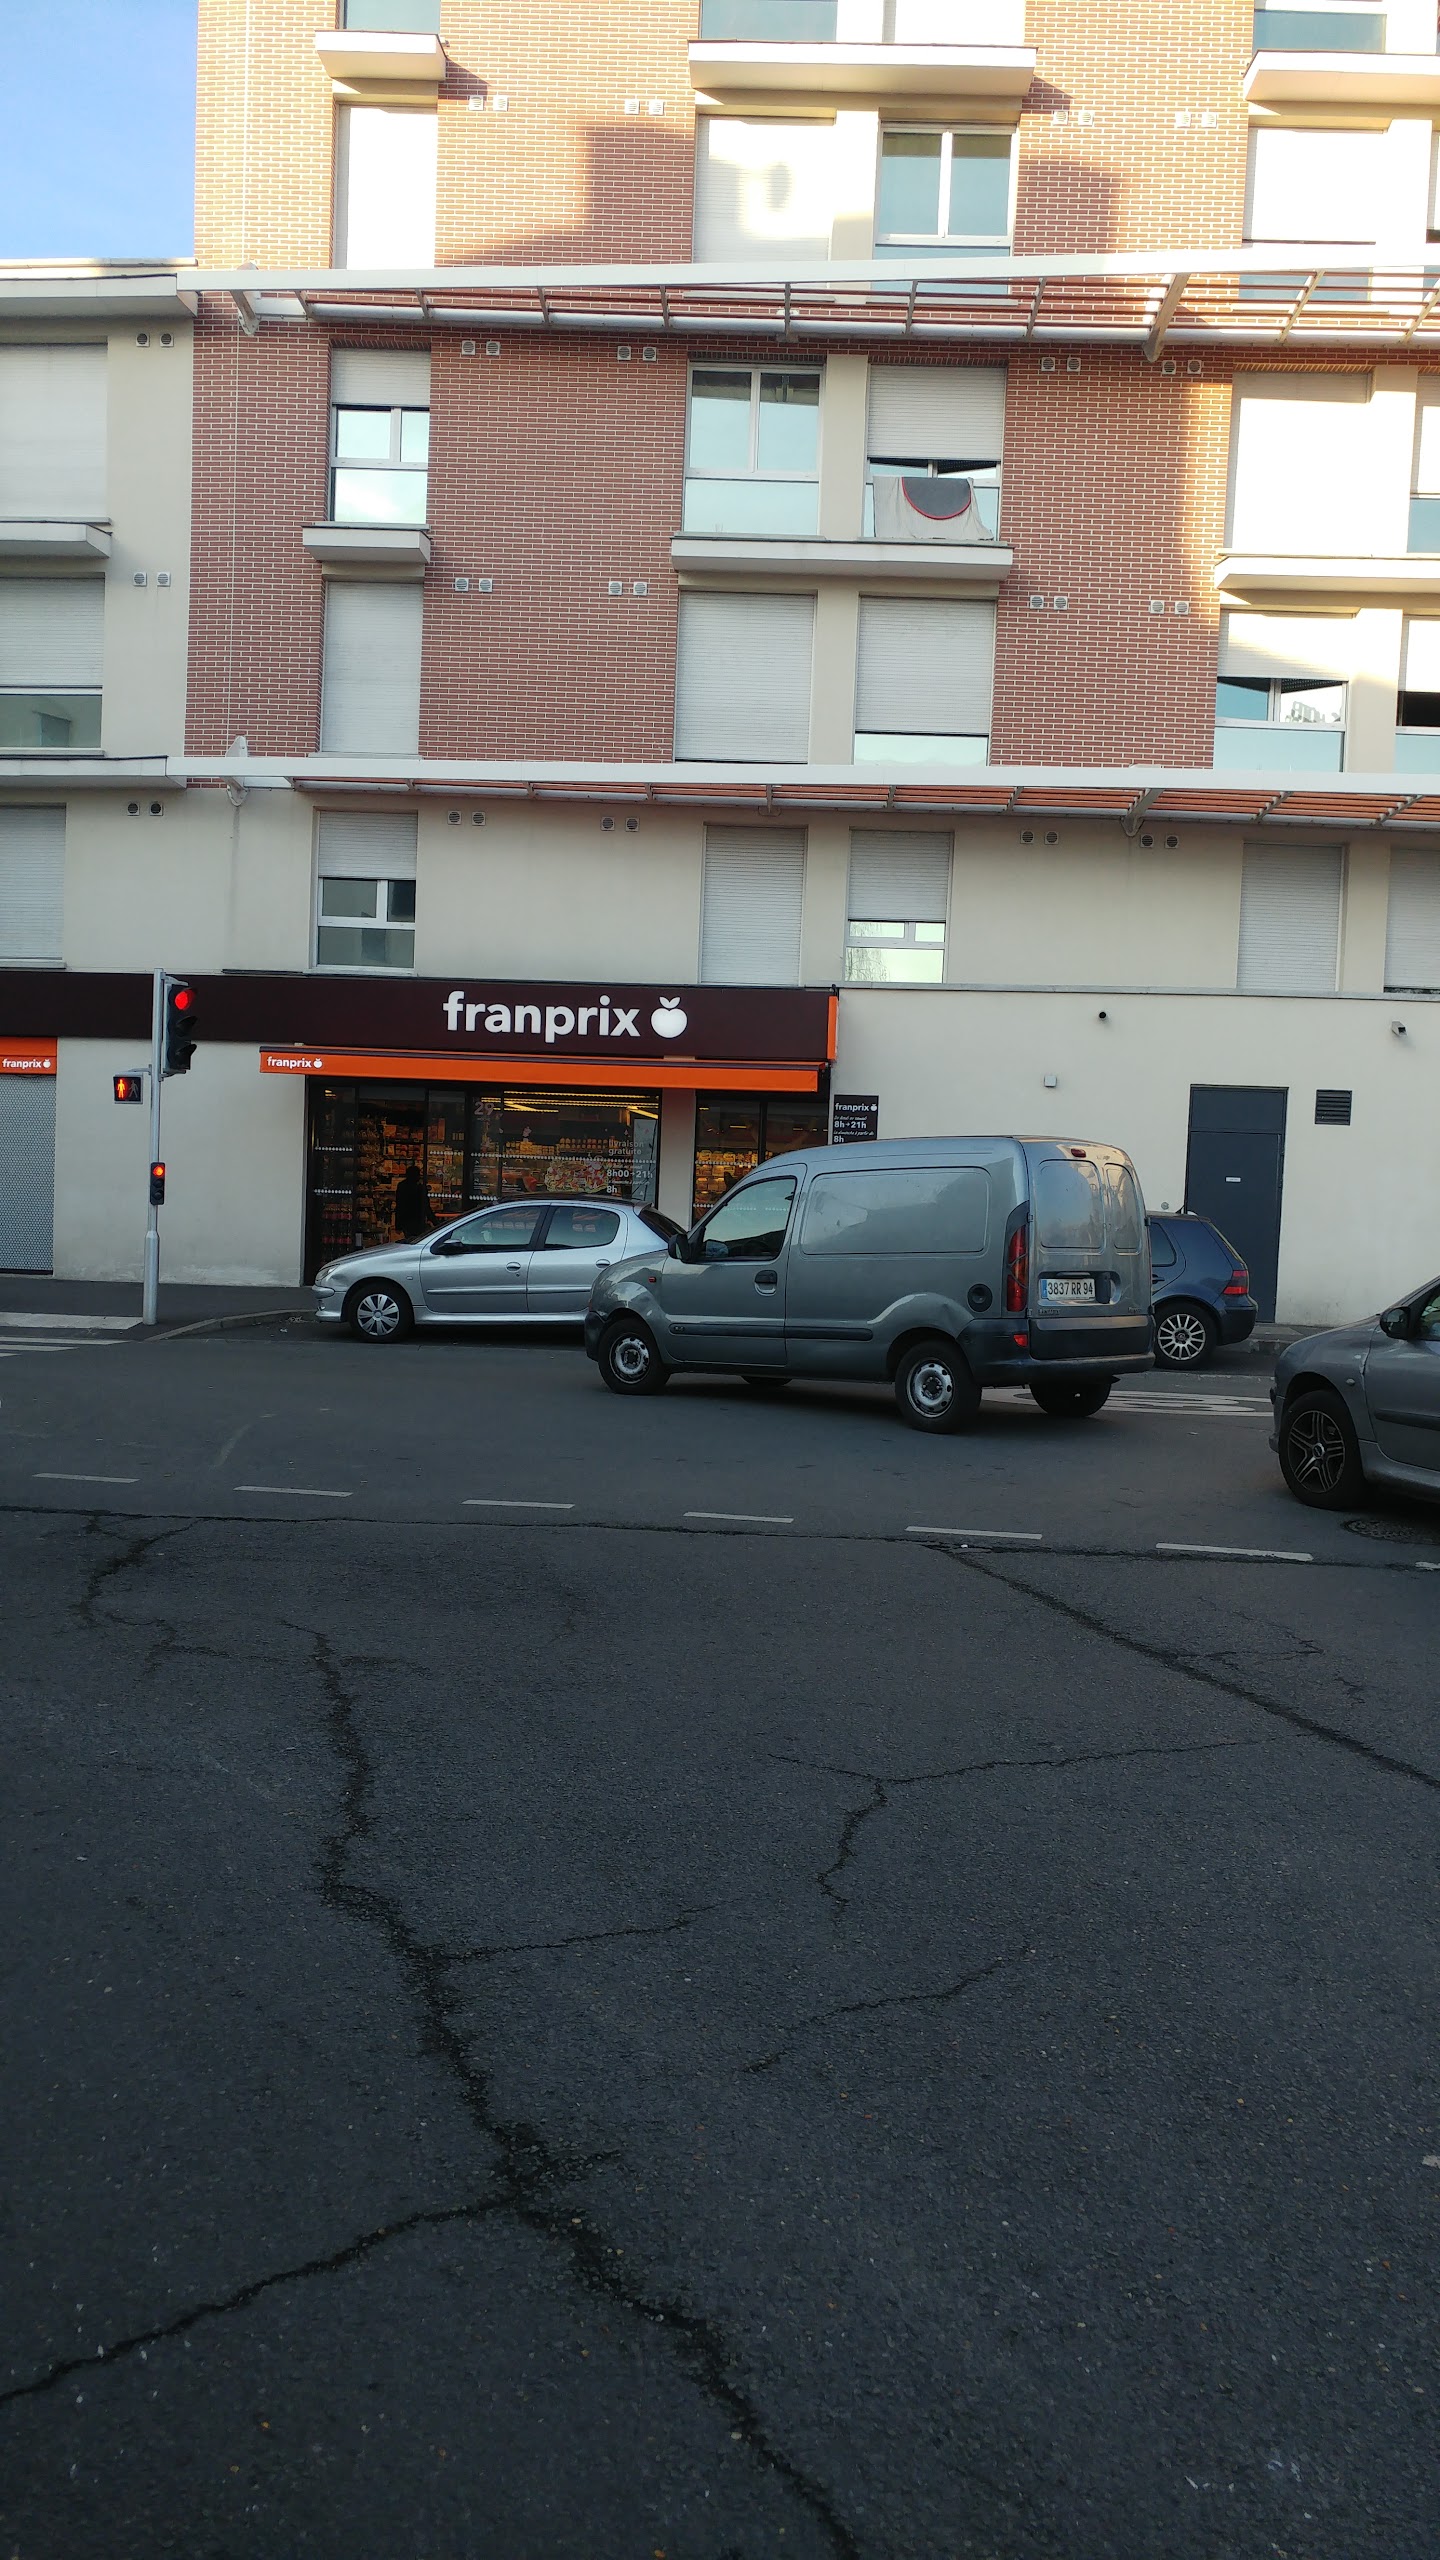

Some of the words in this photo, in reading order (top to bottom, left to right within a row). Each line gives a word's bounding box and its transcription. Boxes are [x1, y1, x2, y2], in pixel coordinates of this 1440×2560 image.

[443, 990, 641, 1043] franprix
[2, 1059, 42, 1069] franprix
[267, 1056, 312, 1069] franprix
[835, 1103, 870, 1112] franprix
[833, 1135, 844, 1143] 8h
[606, 1185, 618, 1193] 8h
[1047, 1282, 1070, 1295] 3837
[1071, 1282, 1082, 1295] RR
[1083, 1281, 1094, 1295] 94
